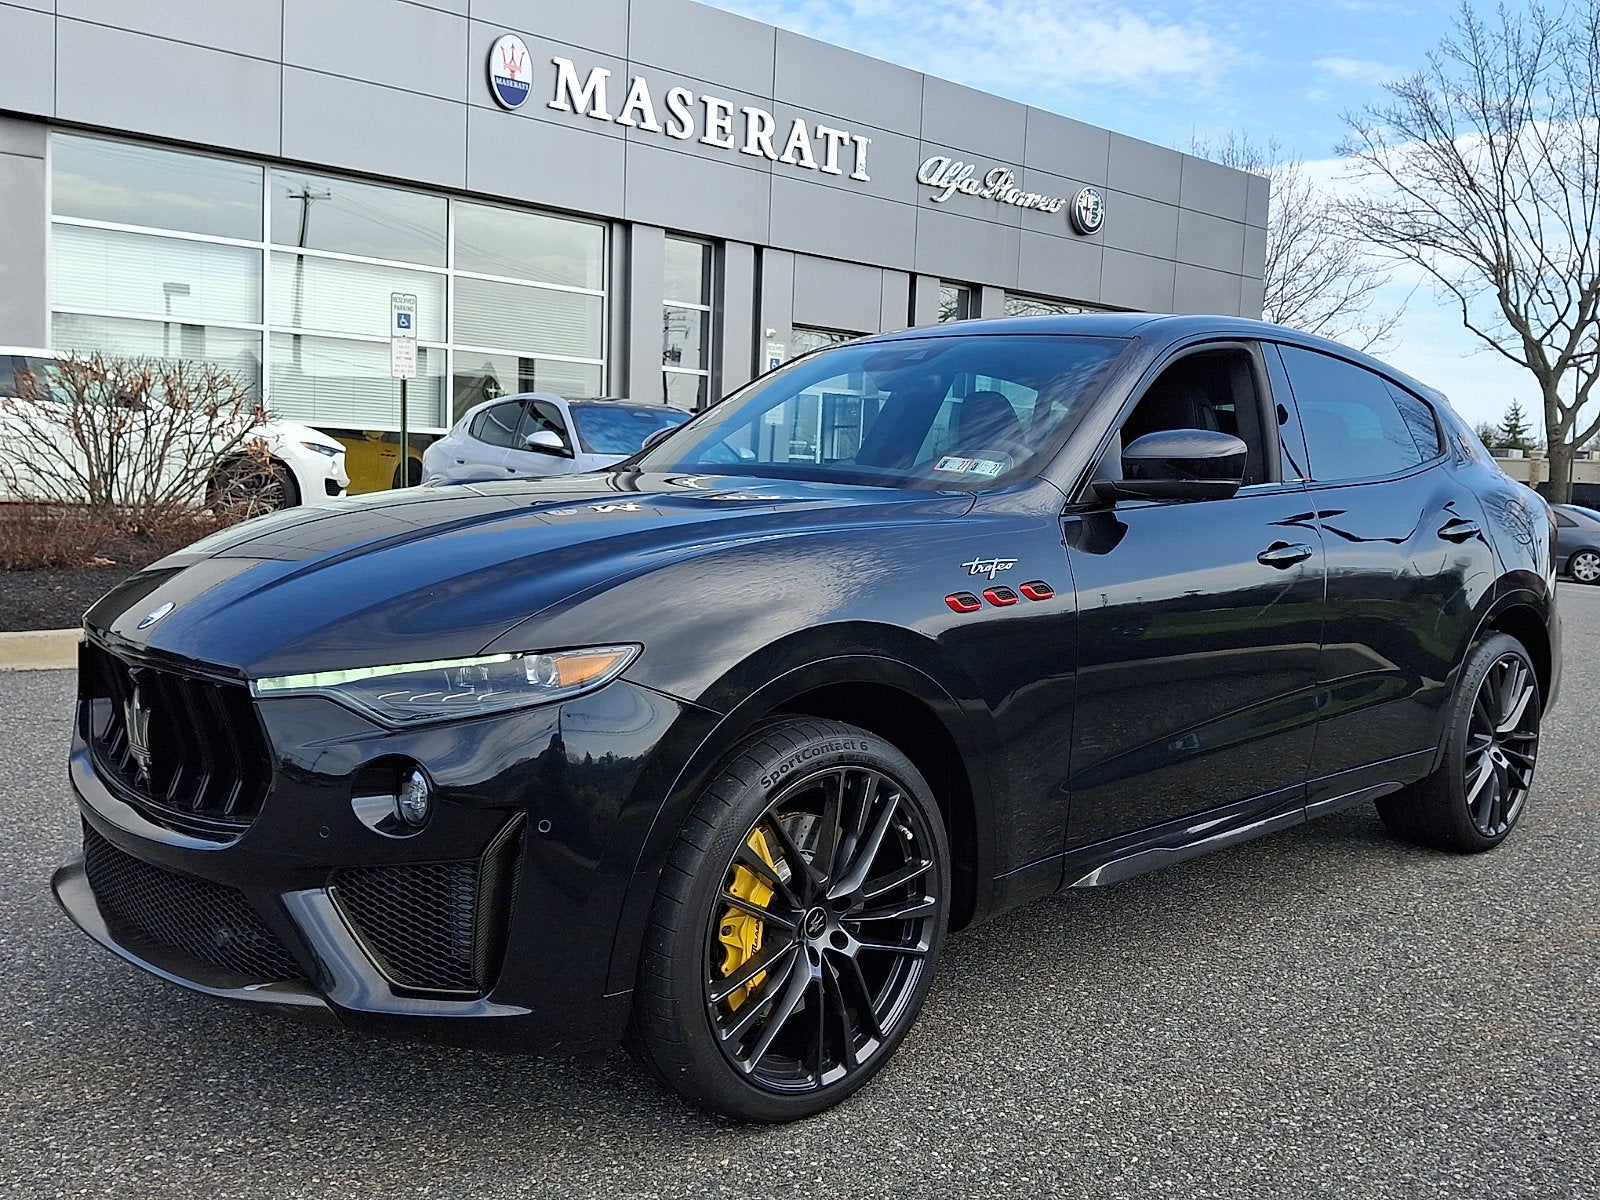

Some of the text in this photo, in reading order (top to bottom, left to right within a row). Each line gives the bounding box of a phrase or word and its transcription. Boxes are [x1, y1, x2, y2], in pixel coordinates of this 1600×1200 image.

[496, 77, 529, 91] MASERATI
[547, 56, 872, 182] MASERATI
[917, 155, 981, 203] Alfa
[979, 167, 1064, 213] Romeo
[392, 296, 416, 305] RESERVED
[393, 304, 414, 312] PARKING
[960, 557, 1018, 580] trofeo
[760, 741, 856, 789] SportContact
[859, 741, 868, 751] 6
[751, 919, 761, 956] Maser
